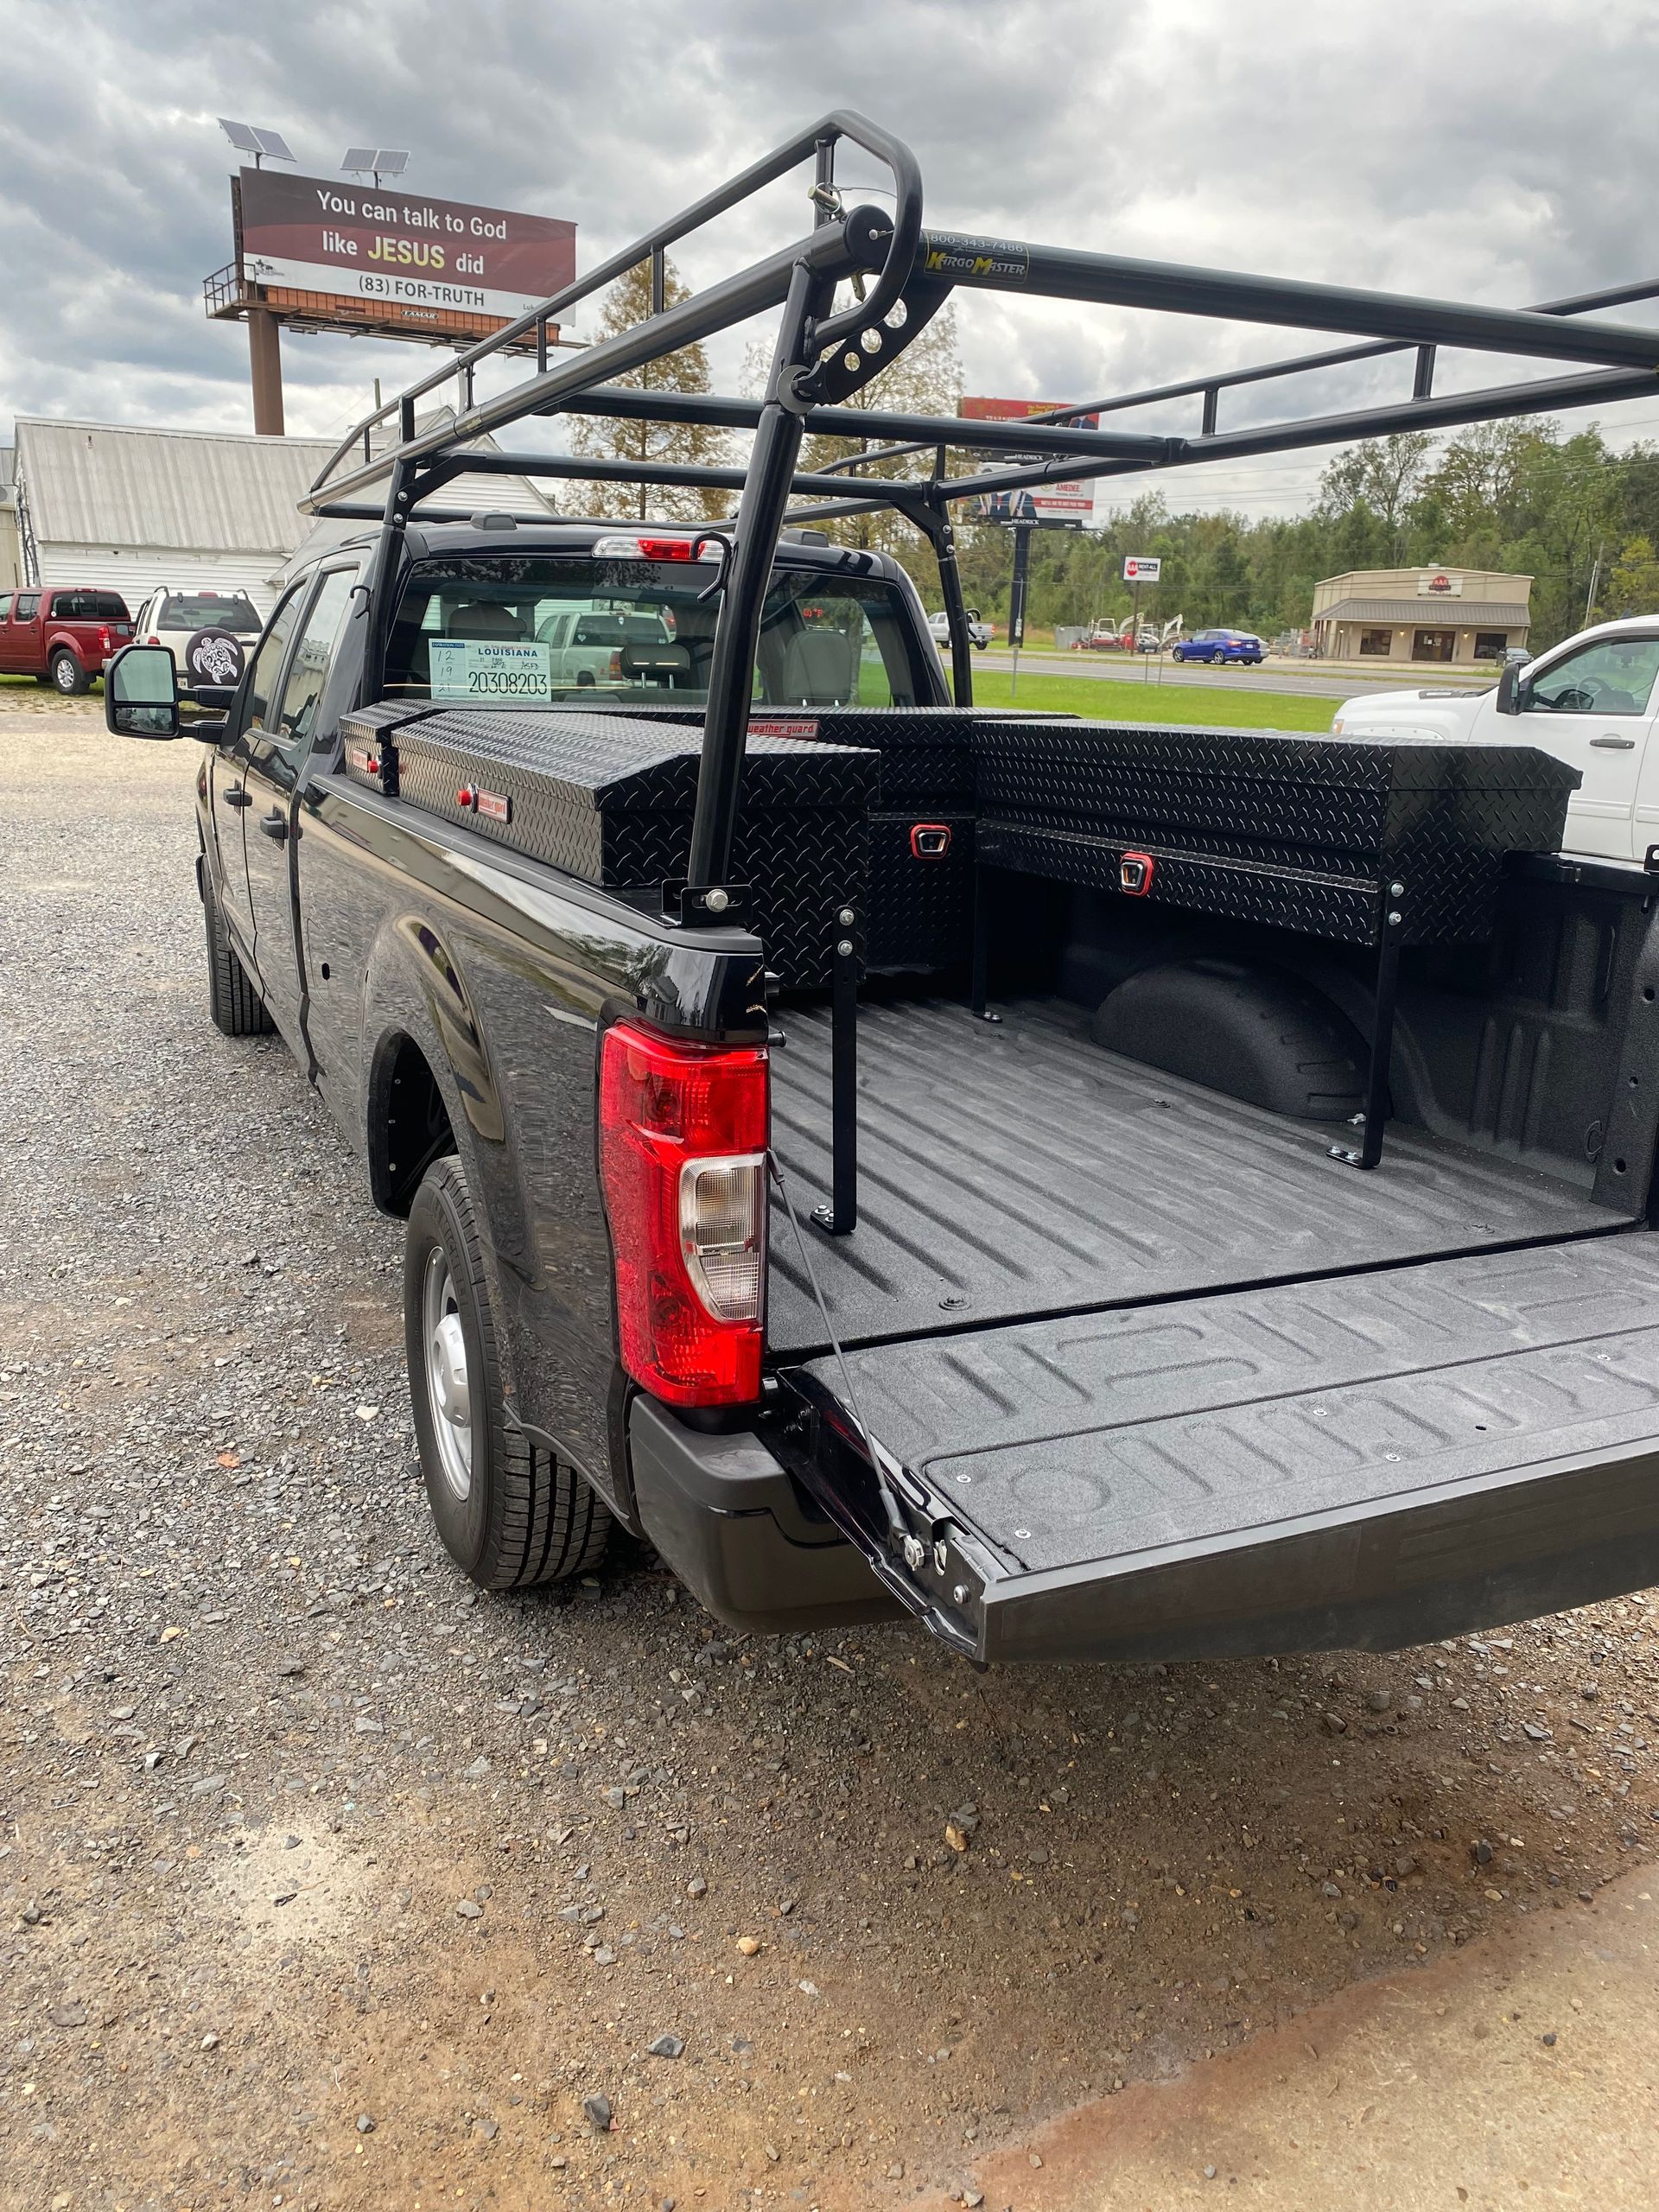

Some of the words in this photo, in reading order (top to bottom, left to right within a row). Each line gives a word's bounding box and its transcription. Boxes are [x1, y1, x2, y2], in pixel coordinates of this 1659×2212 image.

[316, 189, 355, 215] You
[361, 203, 397, 222] can
[403, 207, 440, 229] talk
[445, 213, 464, 232] to
[470, 217, 506, 239] God
[931, 234, 1023, 252] 800-343-7486
[322, 231, 358, 256] like
[367, 236, 445, 269] JESUS
[455, 252, 484, 275] did
[359, 275, 390, 296] (83)
[395, 281, 485, 306] FOR-TRUTH
[437, 650, 455, 663] 12
[478, 648, 537, 657] LOUISIANA
[441, 665, 453, 677] 19
[468, 671, 547, 695] 20308203
[786, 725, 814, 735] guard
